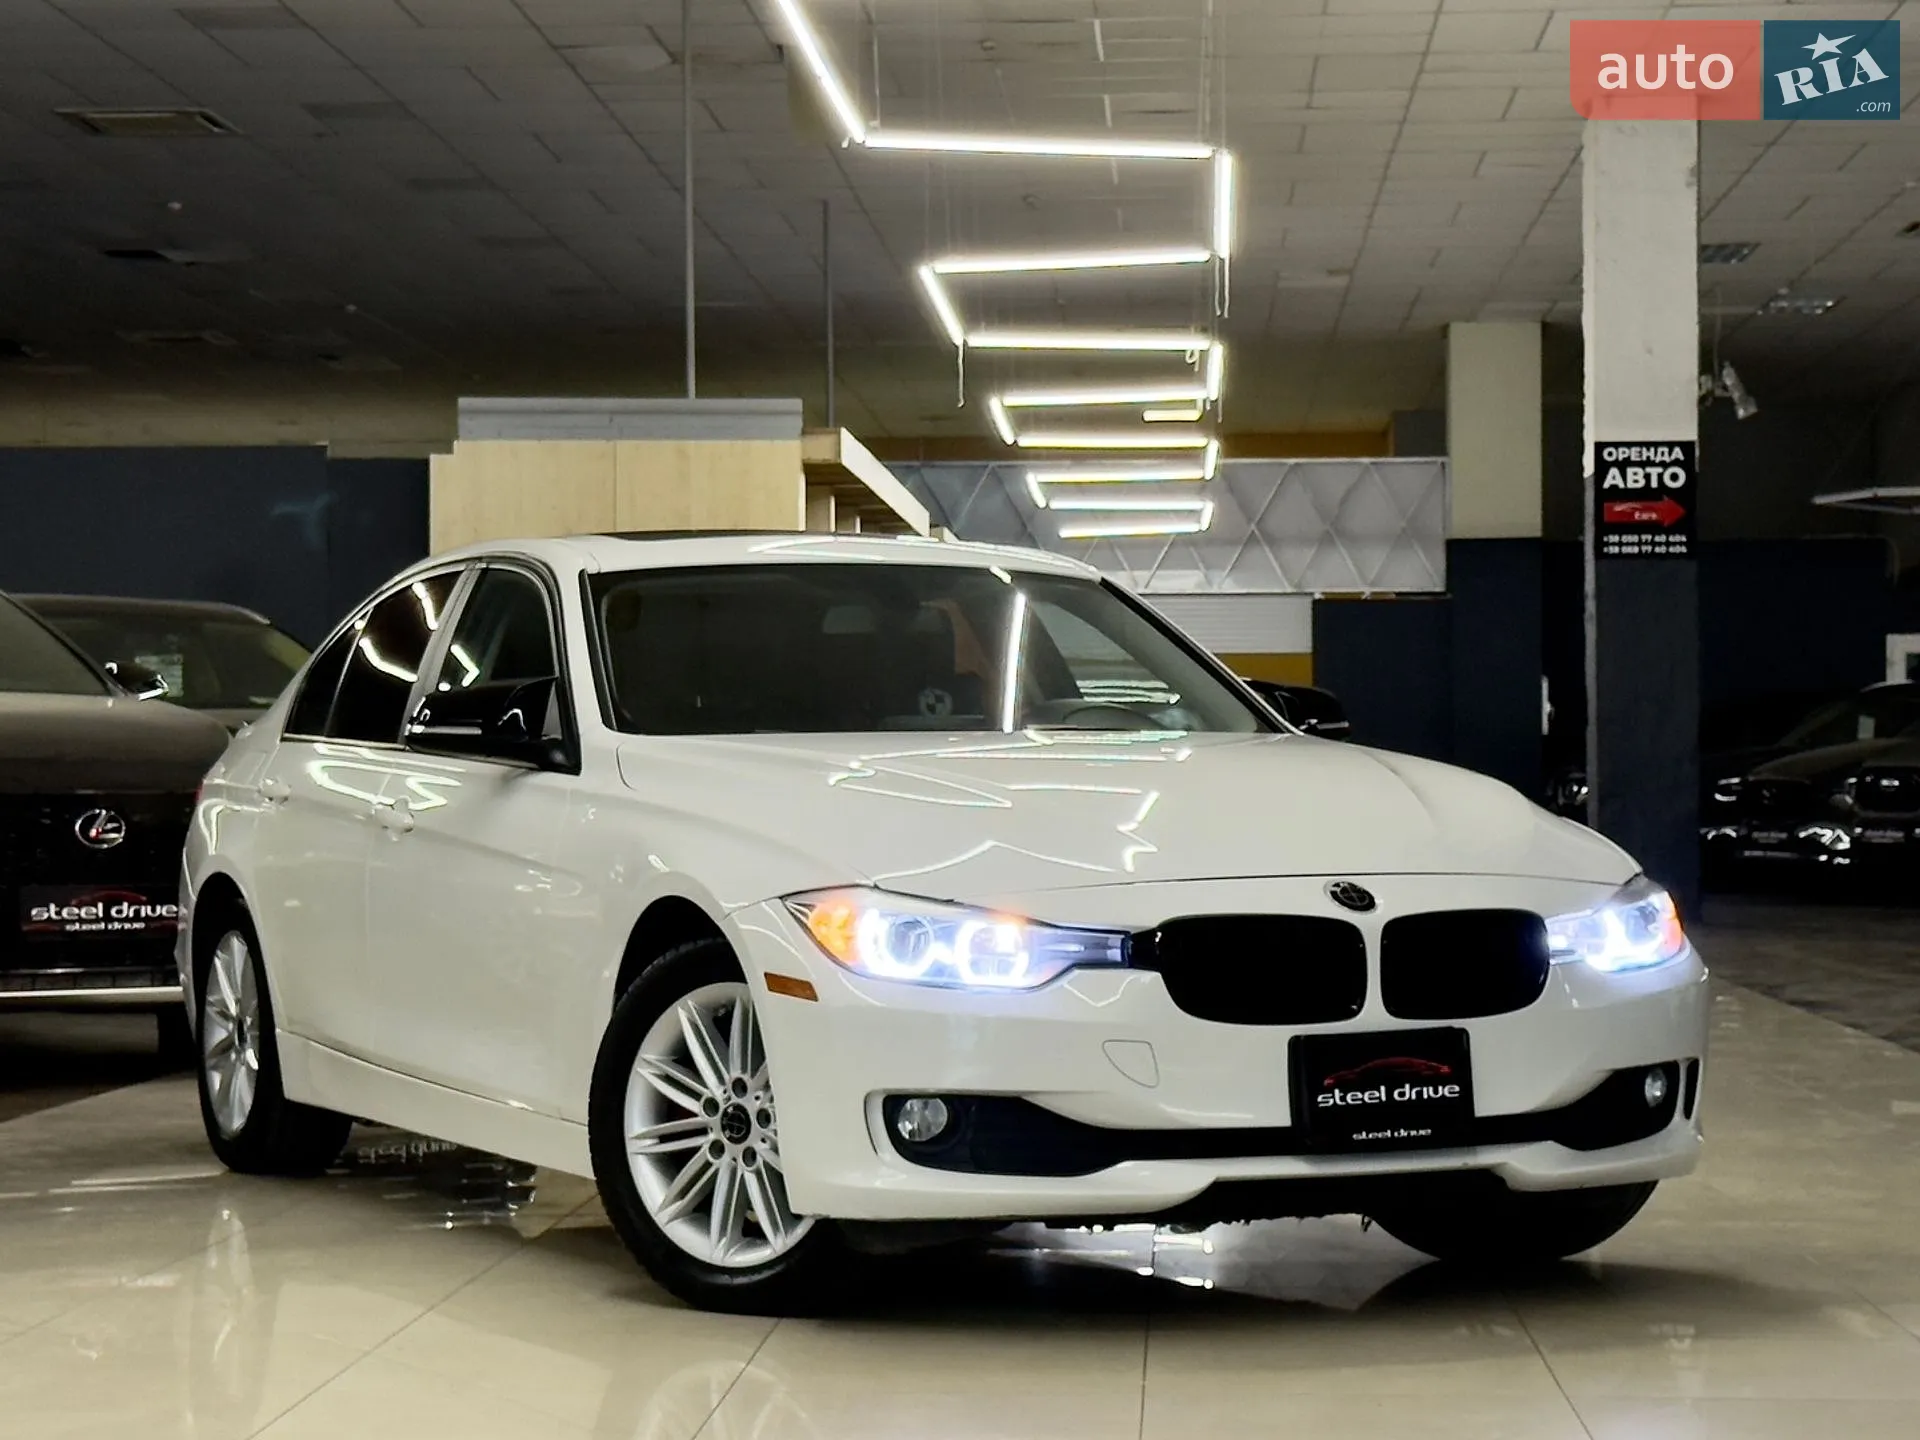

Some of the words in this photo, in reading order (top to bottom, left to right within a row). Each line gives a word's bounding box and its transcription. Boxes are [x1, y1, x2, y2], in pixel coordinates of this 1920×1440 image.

[1602, 446, 1685, 463] ОРЕНДА
[1602, 466, 1687, 489] АВТО
[31, 902, 104, 921] steel
[110, 901, 179, 919] drive
[65, 922, 105, 932] steel
[107, 921, 146, 930] drive
[1317, 1085, 1386, 1107] steel
[1393, 1083, 1460, 1101] drive
[1352, 1129, 1391, 1140] steel
[1394, 1128, 1432, 1138] drive
